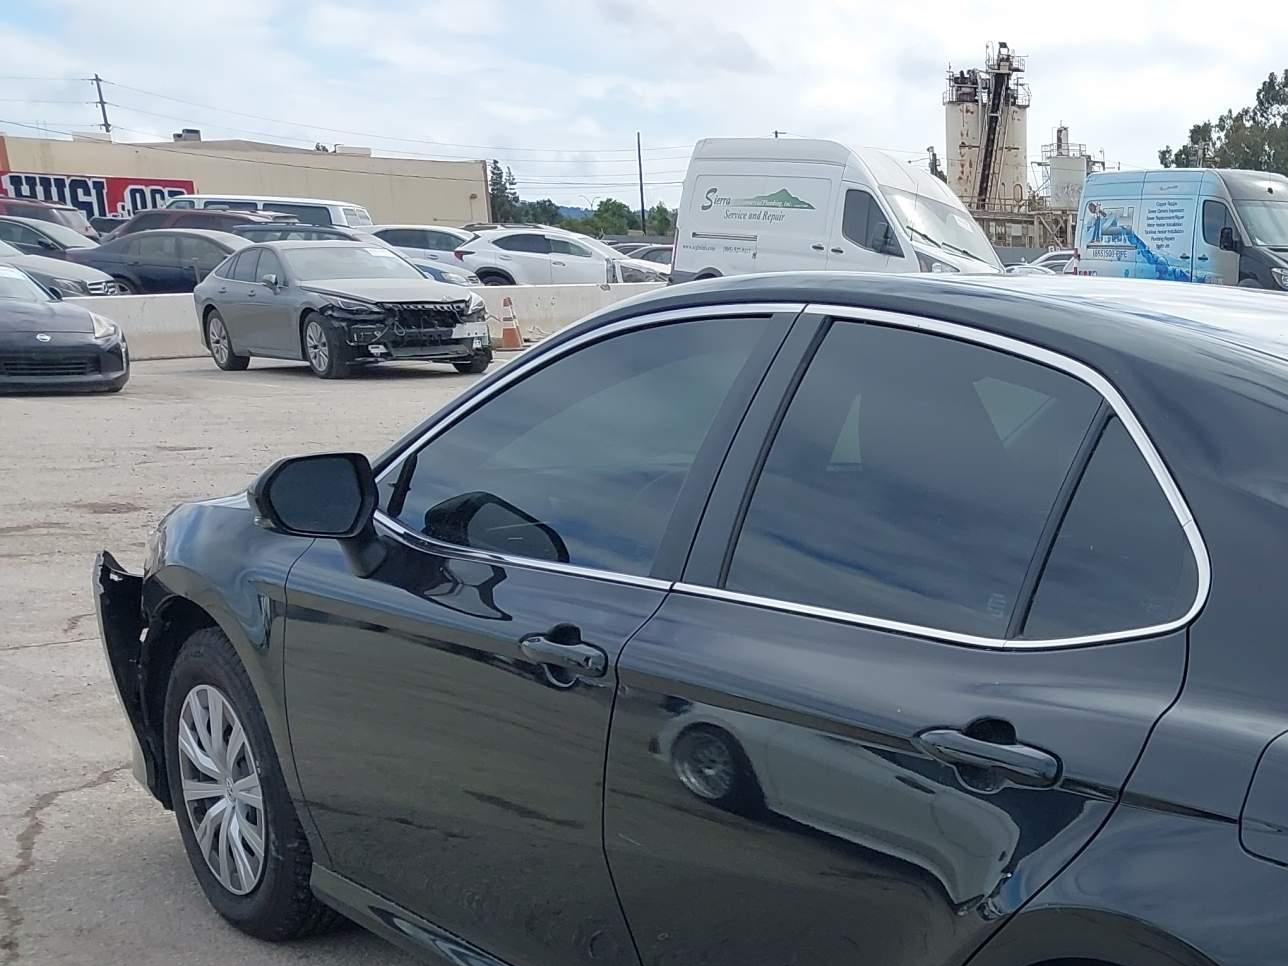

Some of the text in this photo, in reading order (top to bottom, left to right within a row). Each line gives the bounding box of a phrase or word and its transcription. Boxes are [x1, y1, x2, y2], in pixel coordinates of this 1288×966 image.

[701, 187, 731, 211] Sierra
[724, 210, 785, 222] Service and Repair
